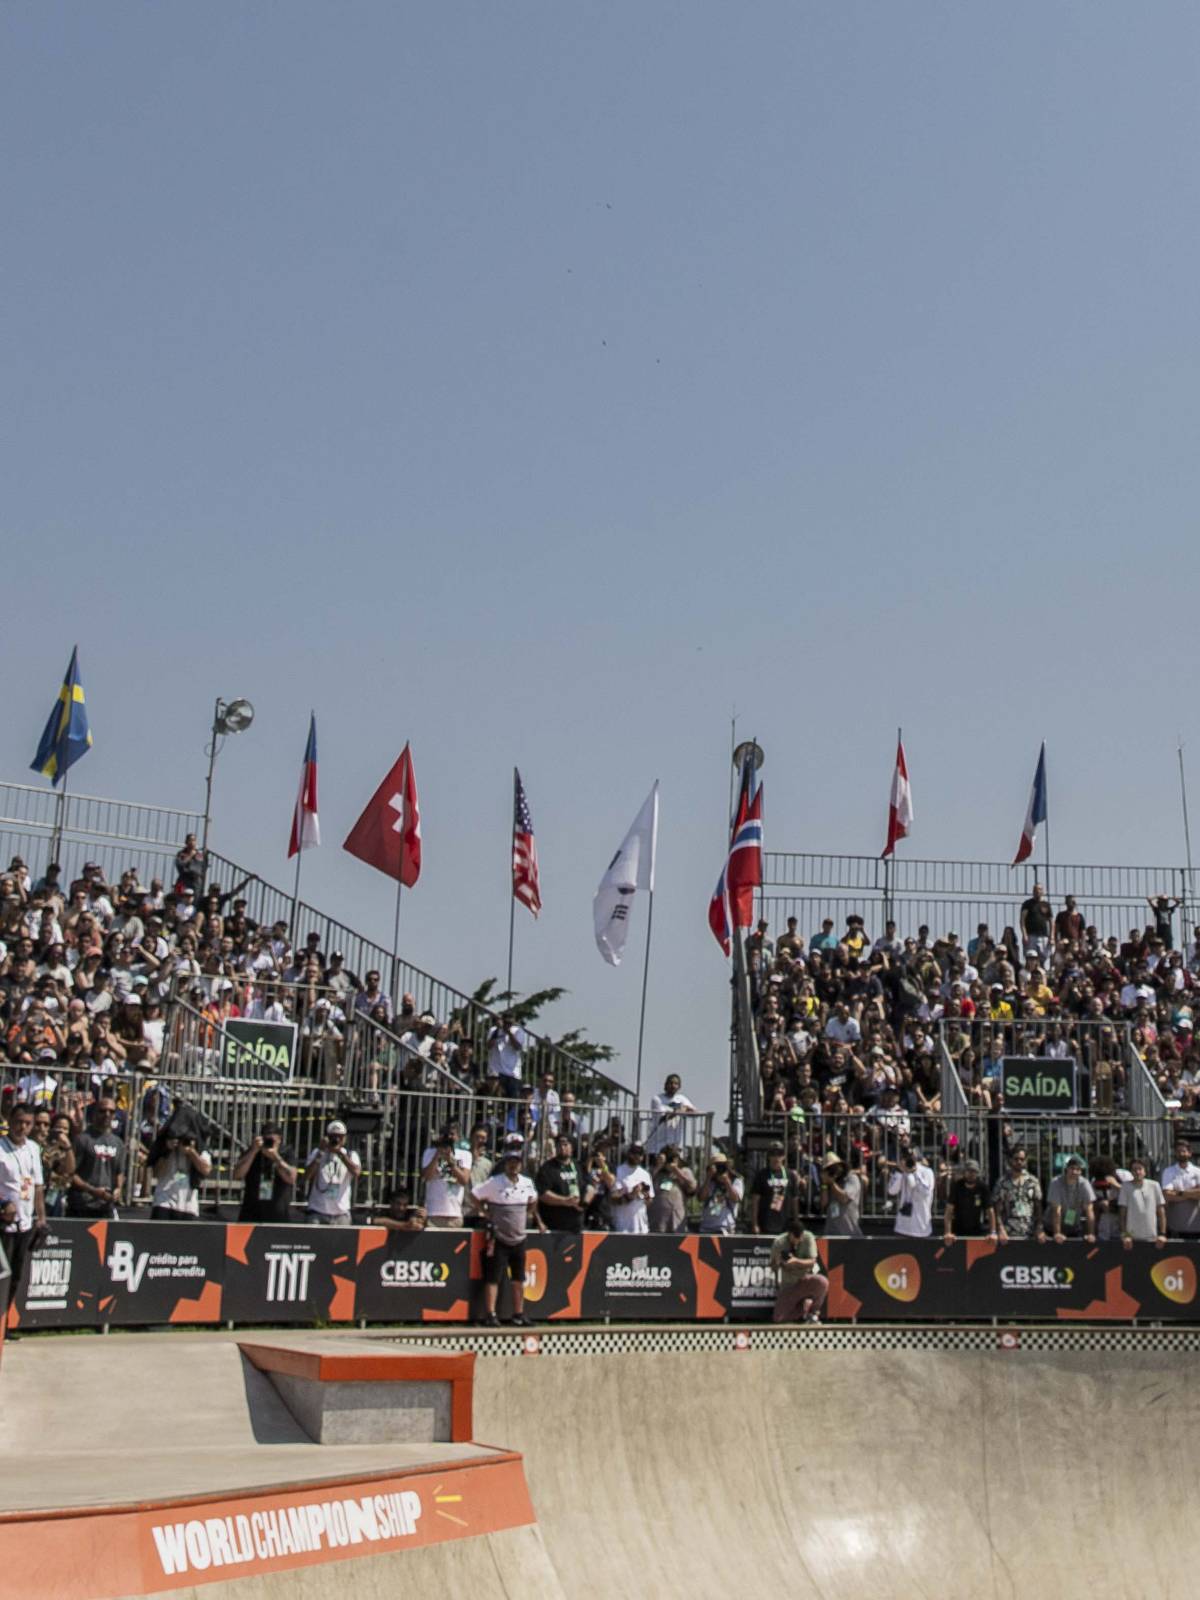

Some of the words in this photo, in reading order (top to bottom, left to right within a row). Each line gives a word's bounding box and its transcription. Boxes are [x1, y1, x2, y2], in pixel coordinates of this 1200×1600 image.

[227, 1037, 290, 1069] SAÍDA
[1005, 1072, 1072, 1098] SAÍDA
[149, 1253, 177, 1265] crédito
[178, 1255, 199, 1266] para
[147, 1267, 171, 1279] quem
[171, 1266, 206, 1278] acredita
[264, 1253, 317, 1302] TNT
[380, 1260, 434, 1282] CBSK
[606, 1262, 632, 1281] SÃO
[632, 1266, 672, 1281] PAULO
[887, 1267, 908, 1290] oi
[1000, 1265, 1057, 1284] CBSK
[1164, 1269, 1184, 1291] oi
[151, 1514, 255, 1576] WORLD
[250, 1490, 422, 1561] CHAMPIONSHIP
